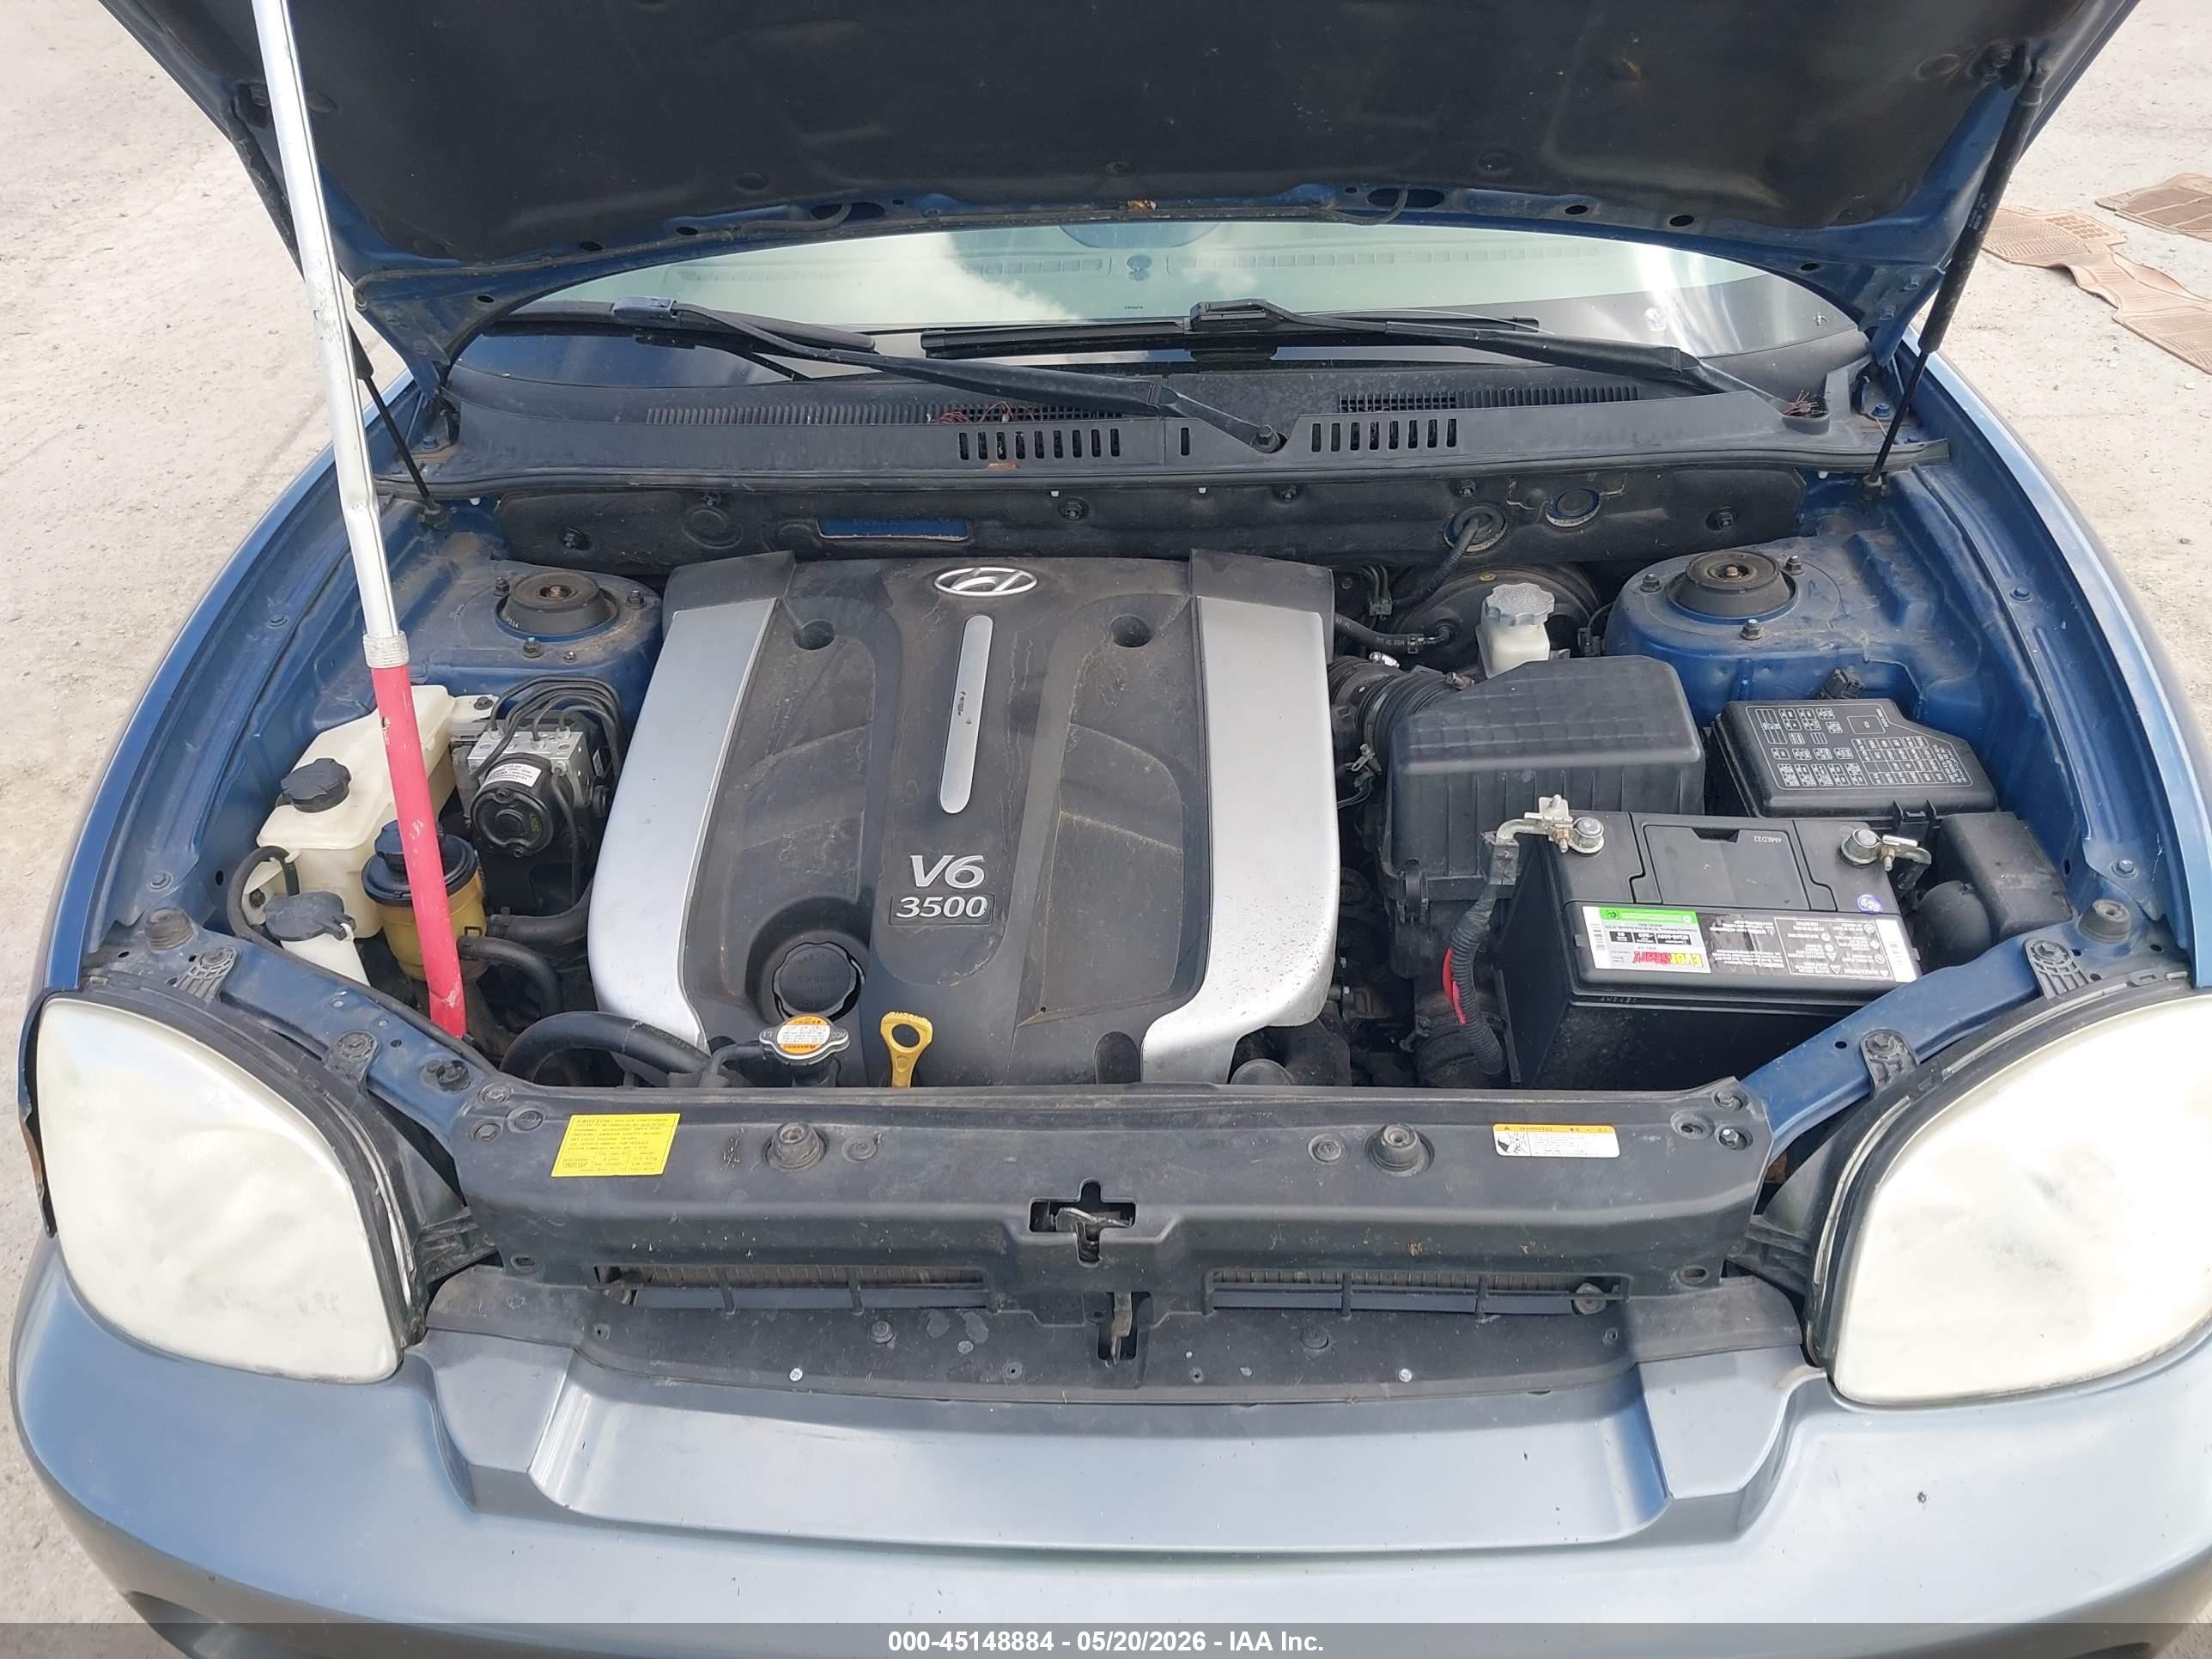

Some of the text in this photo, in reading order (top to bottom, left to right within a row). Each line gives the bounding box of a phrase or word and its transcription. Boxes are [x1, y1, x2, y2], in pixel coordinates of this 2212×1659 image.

[909, 854, 985, 889] V6
[896, 896, 988, 918] 3500
[1632, 952, 1703, 969] EverStart
